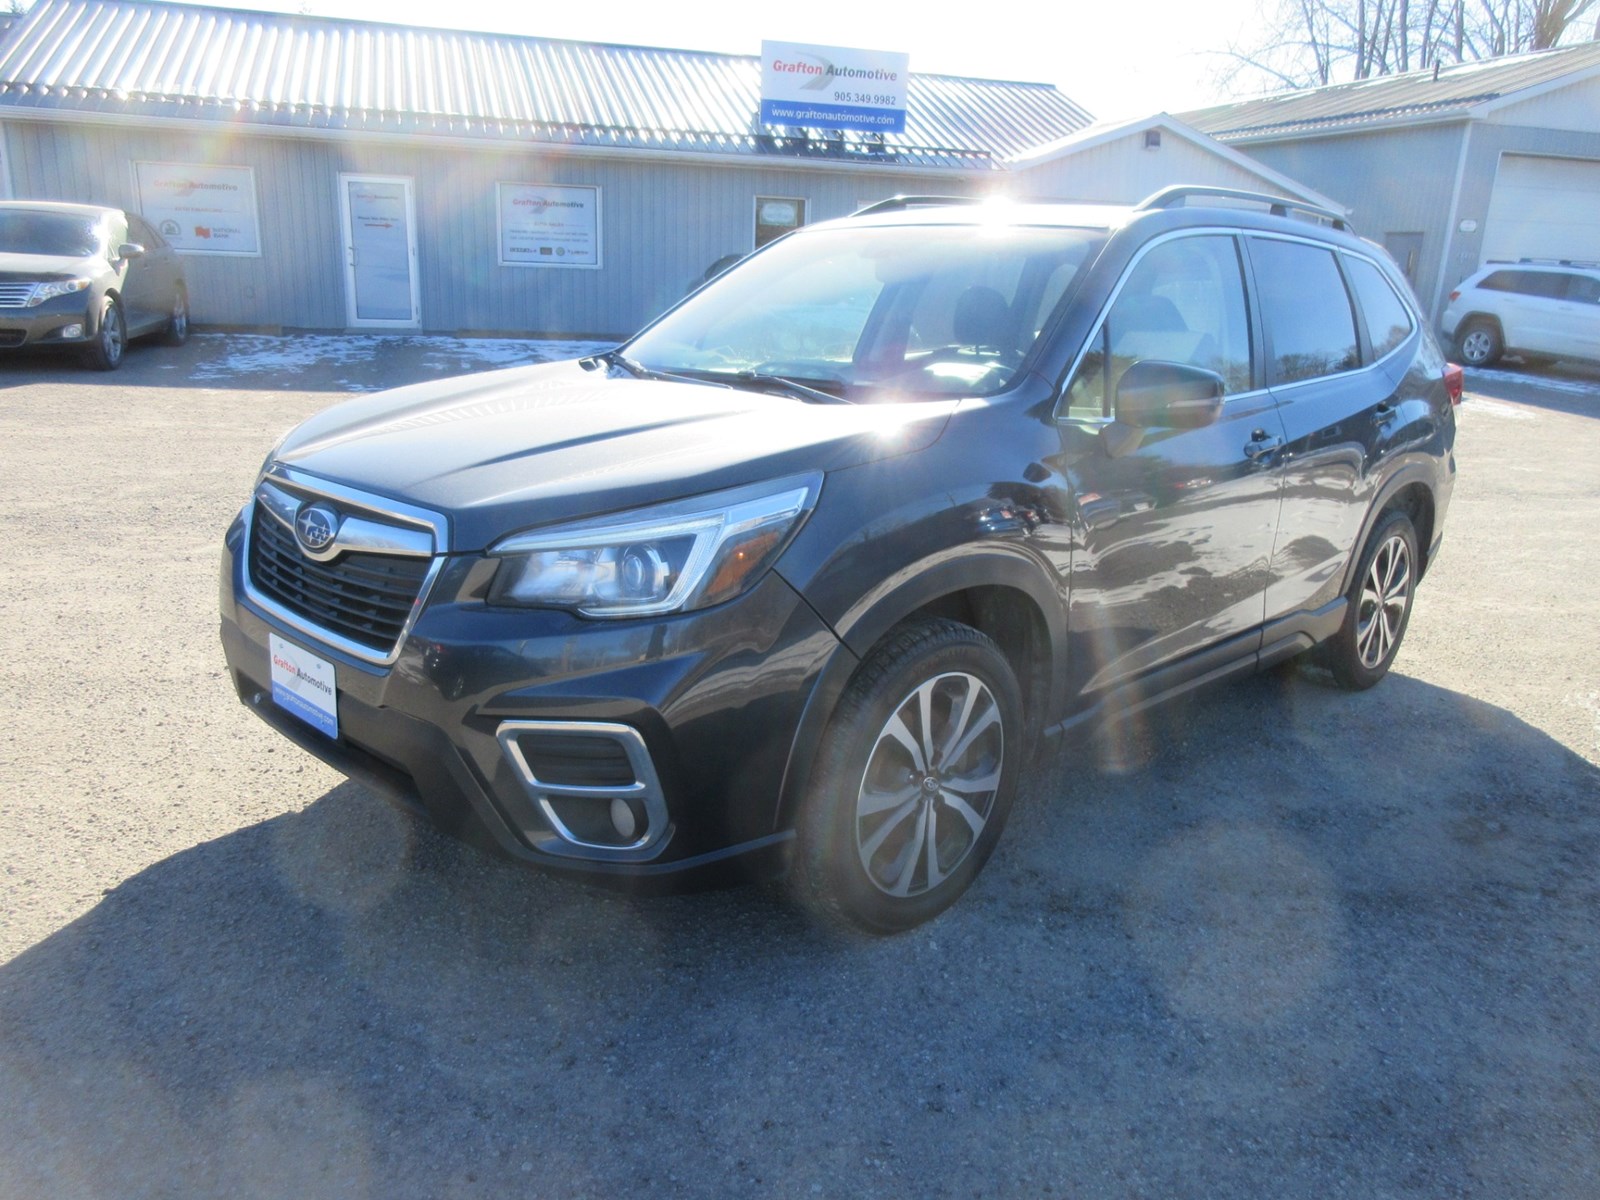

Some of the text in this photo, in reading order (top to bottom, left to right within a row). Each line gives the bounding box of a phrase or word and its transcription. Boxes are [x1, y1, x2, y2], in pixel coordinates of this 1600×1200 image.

[773, 59, 897, 81] Grafton Automotive
[834, 91, 896, 105] 905.349.9982
[772, 107, 895, 125] www.graftonautomotive.com
[189, 181, 238, 191] Automotive
[512, 198, 584, 208] Grafton Automotive
[273, 655, 332, 696] Grafton Automotive
